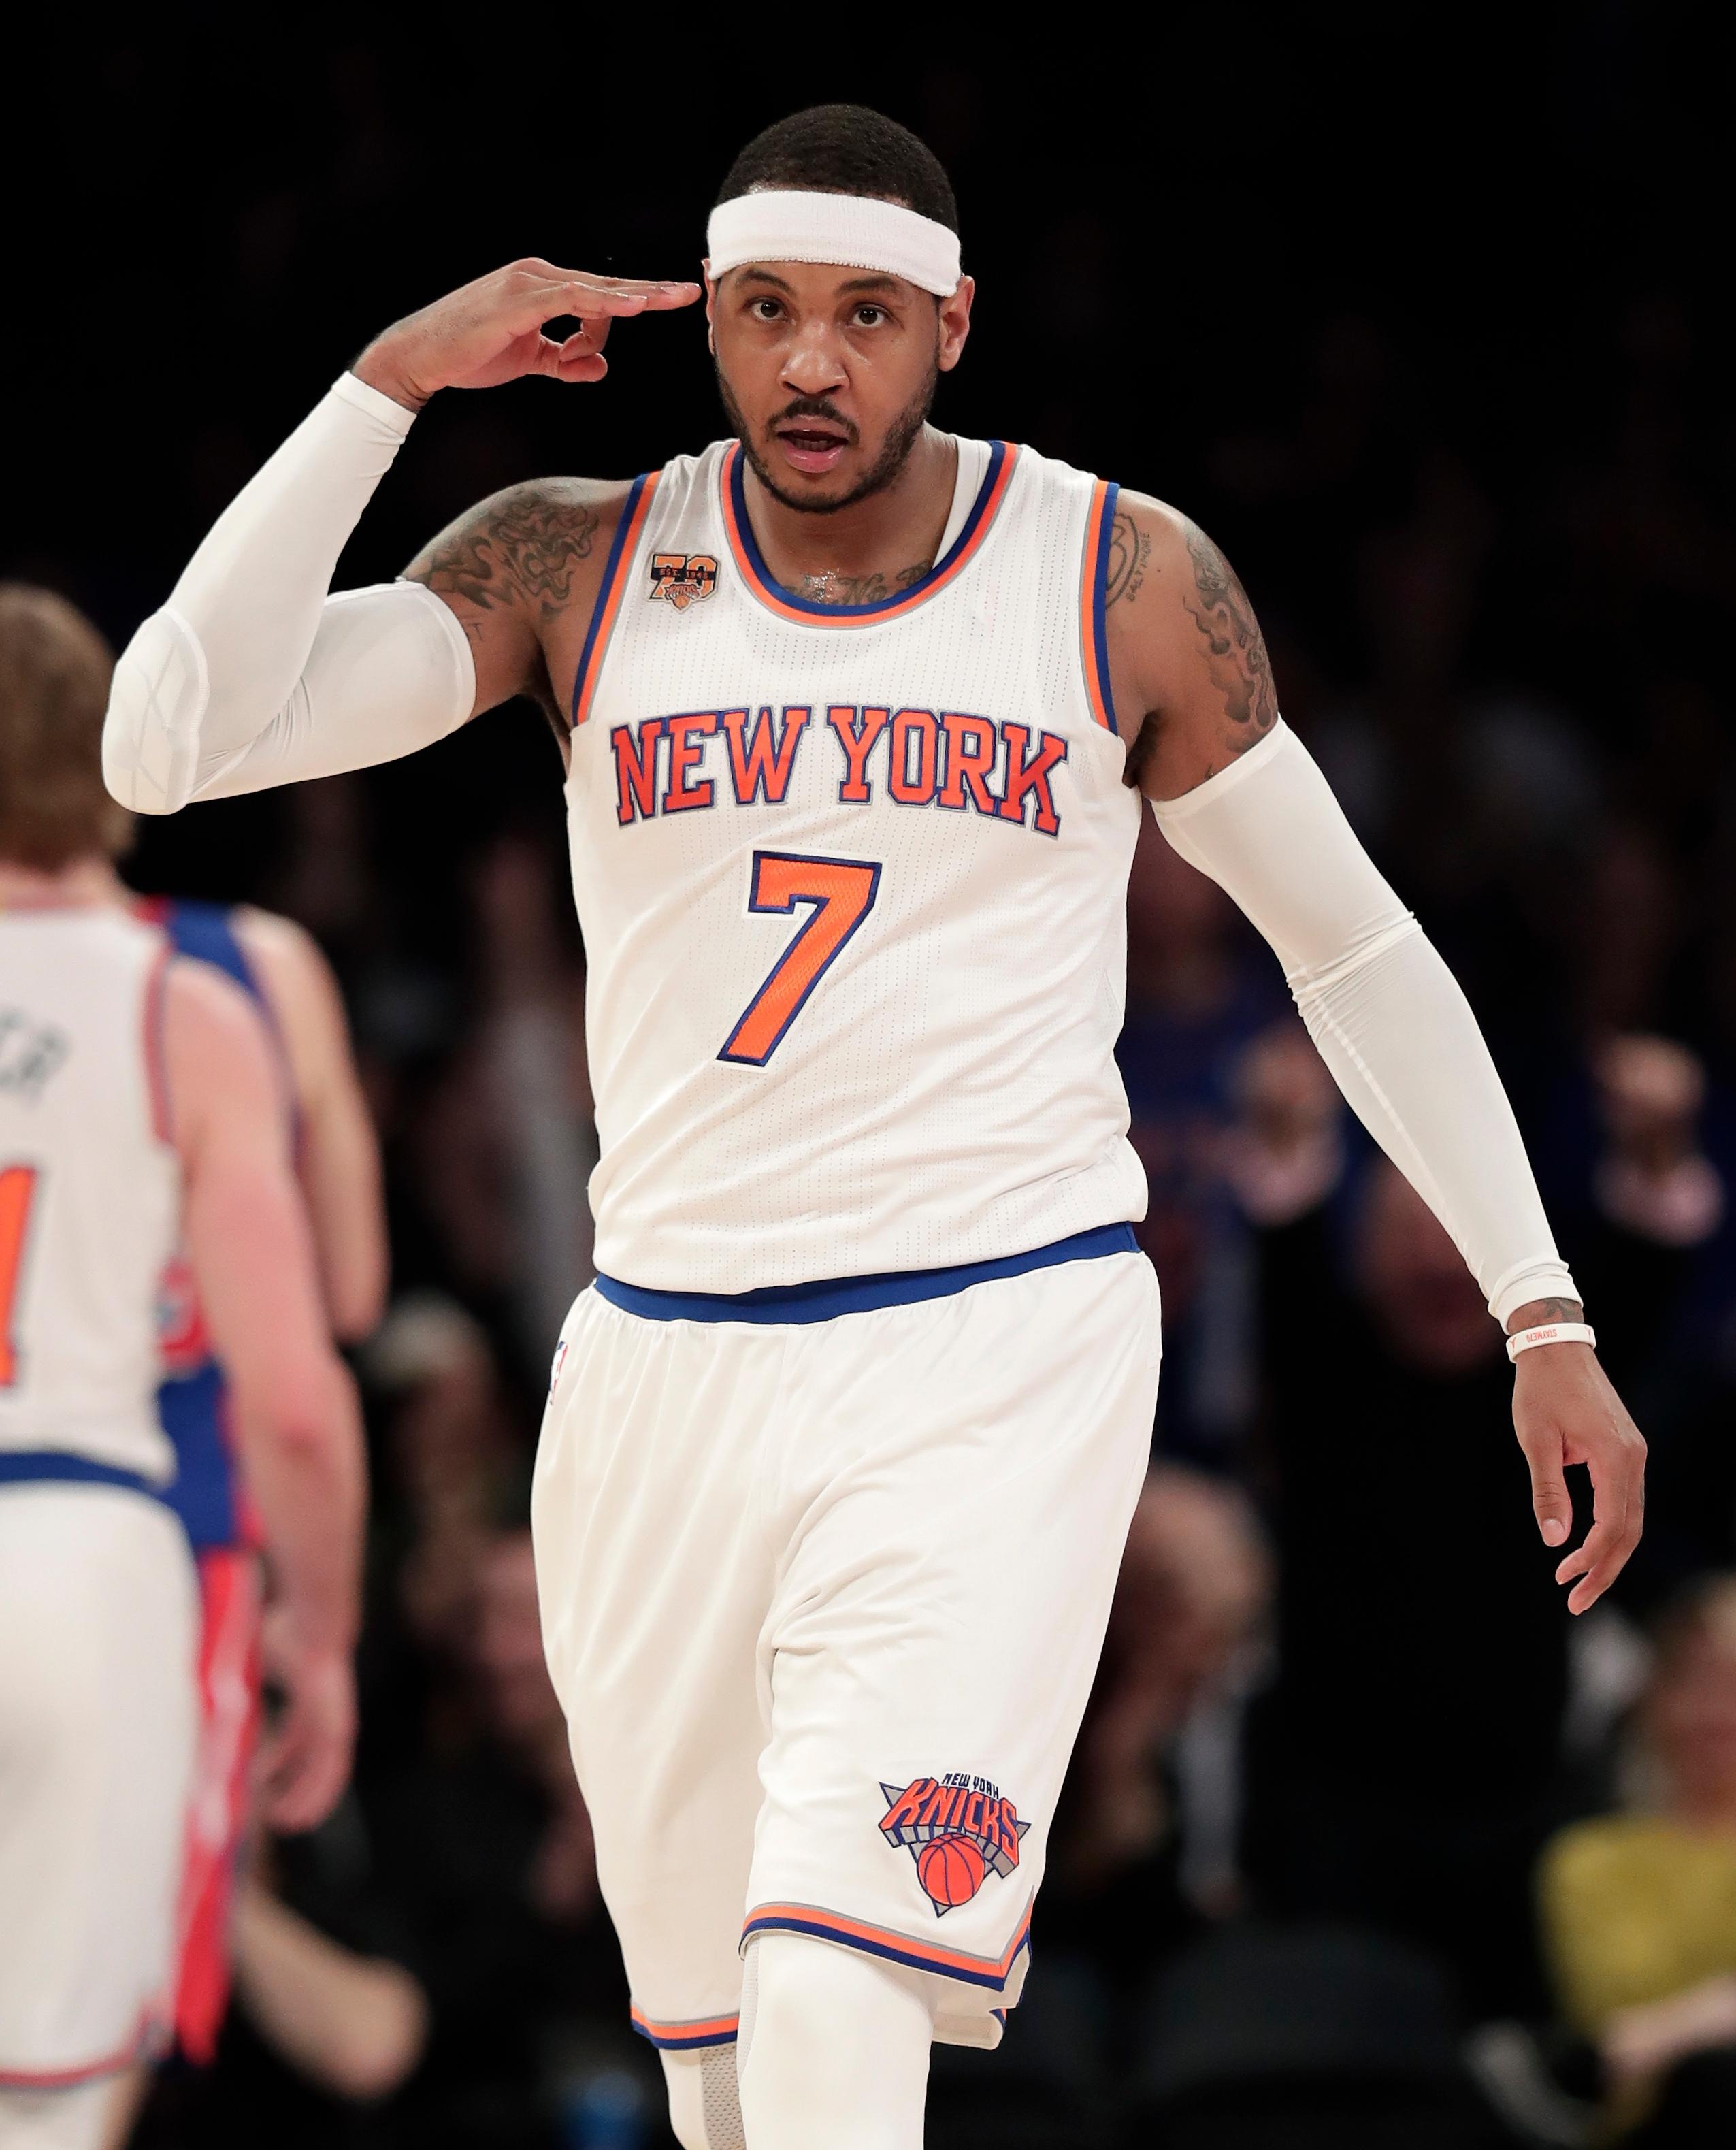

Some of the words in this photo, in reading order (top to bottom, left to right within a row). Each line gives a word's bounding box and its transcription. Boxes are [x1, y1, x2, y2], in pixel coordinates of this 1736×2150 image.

[612, 705, 813, 827] NEW
[825, 705, 1068, 838] YORK
[717, 851, 882, 1066] 7
[878, 1777, 1019, 1869] KNICKS
[942, 1773, 970, 1787] NEW
[973, 1776, 1000, 1799] YORK
